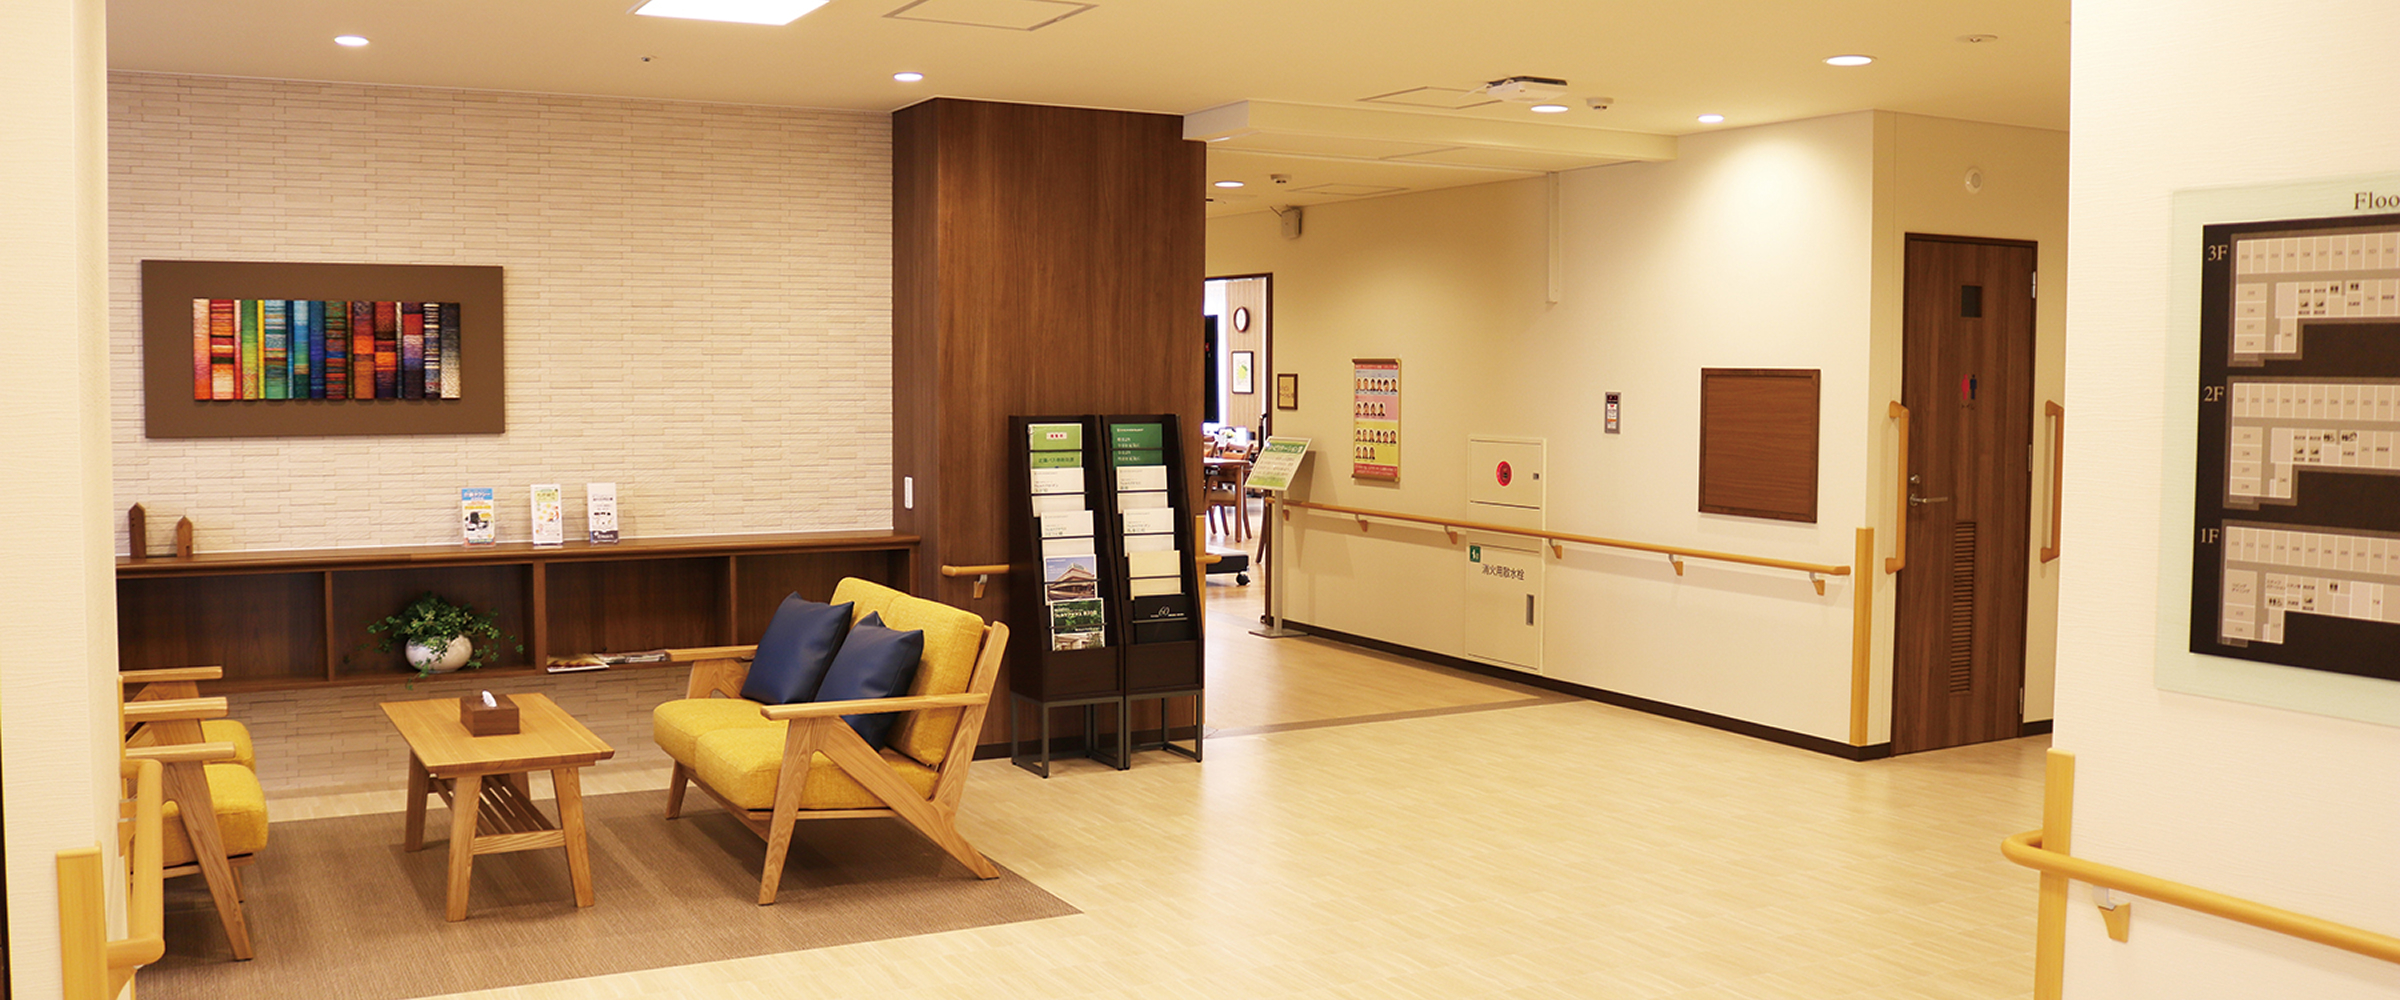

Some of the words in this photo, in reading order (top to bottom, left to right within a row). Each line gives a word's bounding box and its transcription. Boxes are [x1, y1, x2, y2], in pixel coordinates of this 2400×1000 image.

[2207, 244, 2229, 262] 3F
[2203, 385, 2225, 403] 2F
[2200, 529, 2220, 544] 1F
[1482, 563, 1525, 580] 消火用散水栓
